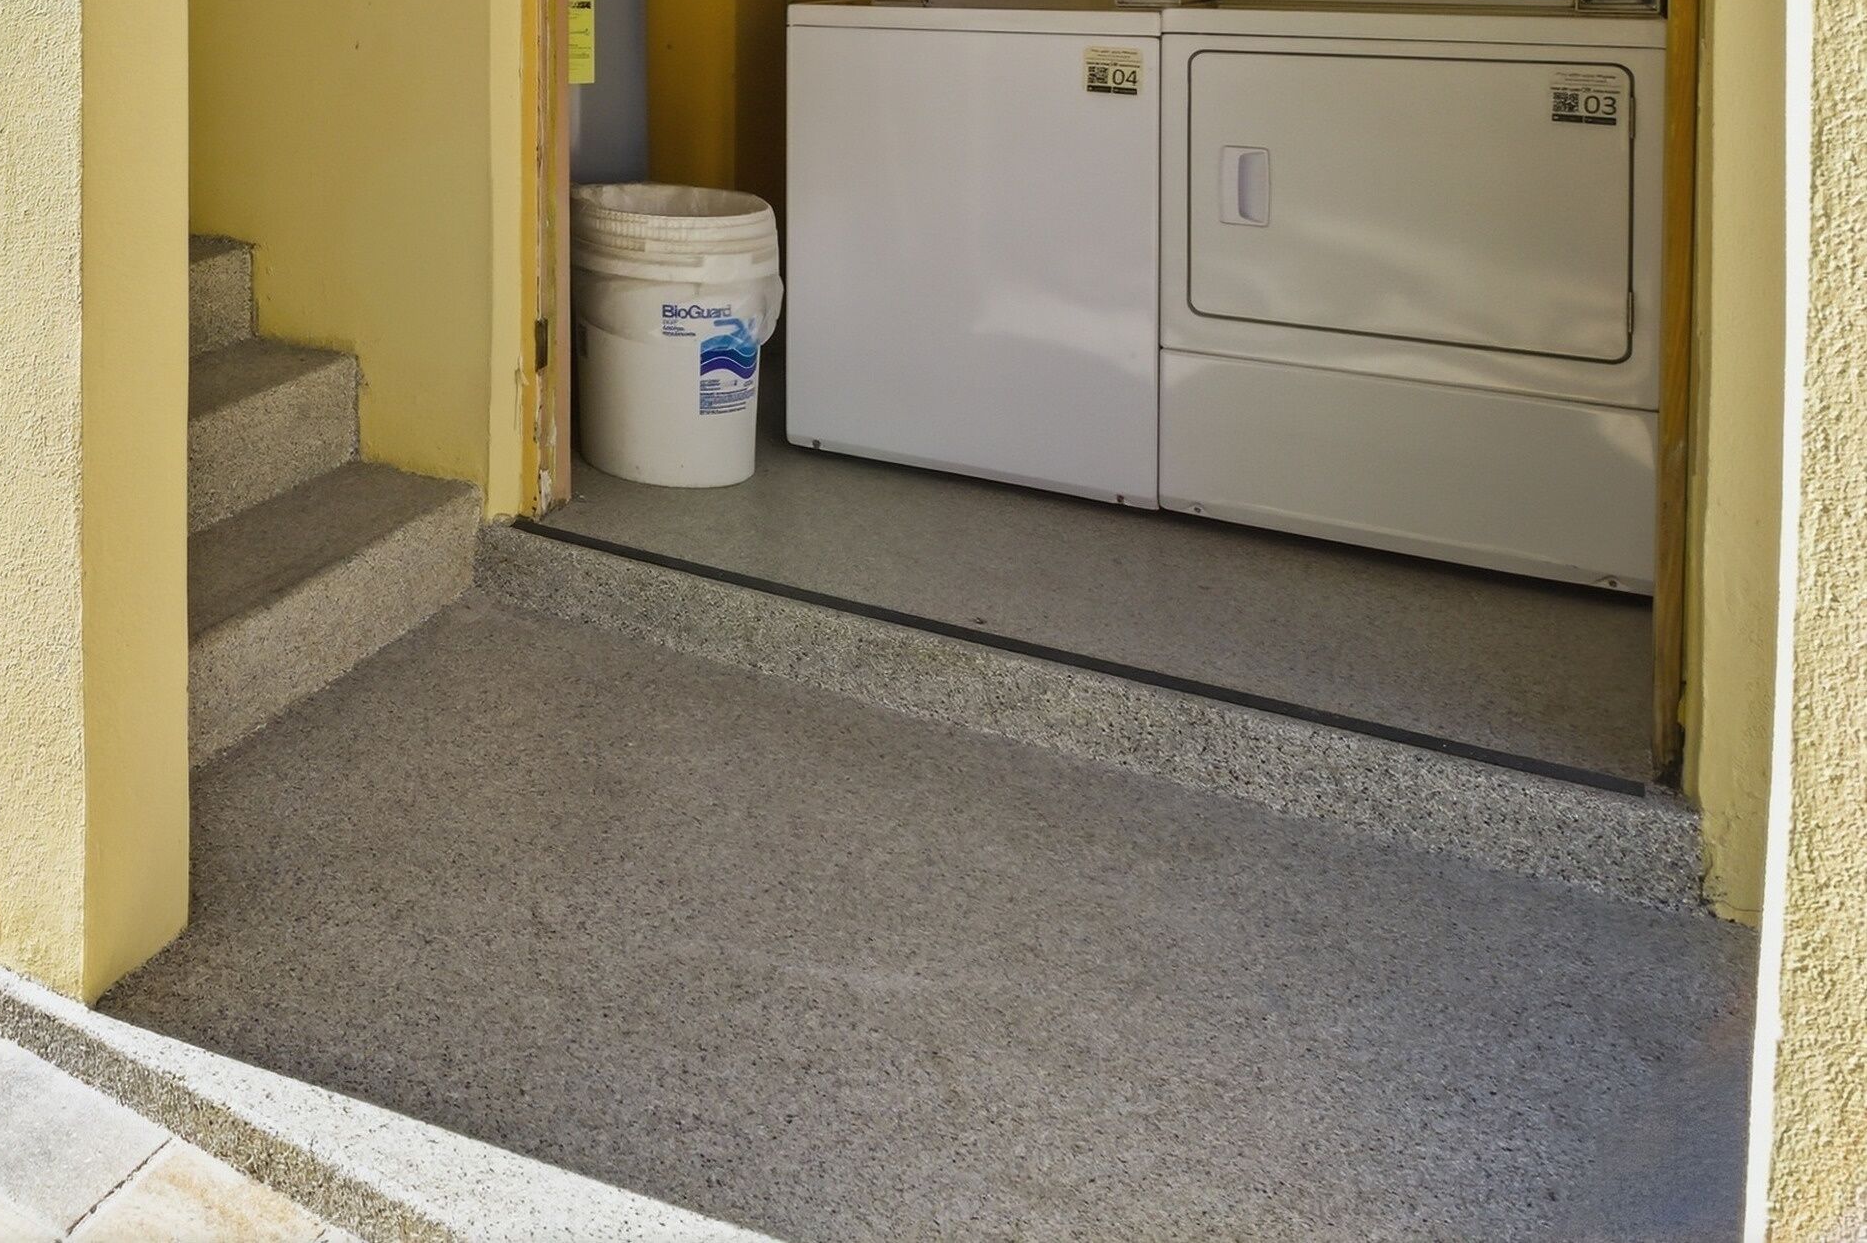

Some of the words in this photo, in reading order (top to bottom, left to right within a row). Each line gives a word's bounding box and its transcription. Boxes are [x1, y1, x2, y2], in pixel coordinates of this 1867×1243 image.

[1113, 69, 1137, 86] 04
[1584, 96, 1617, 115] 03
[662, 304, 731, 319] BioGuard
